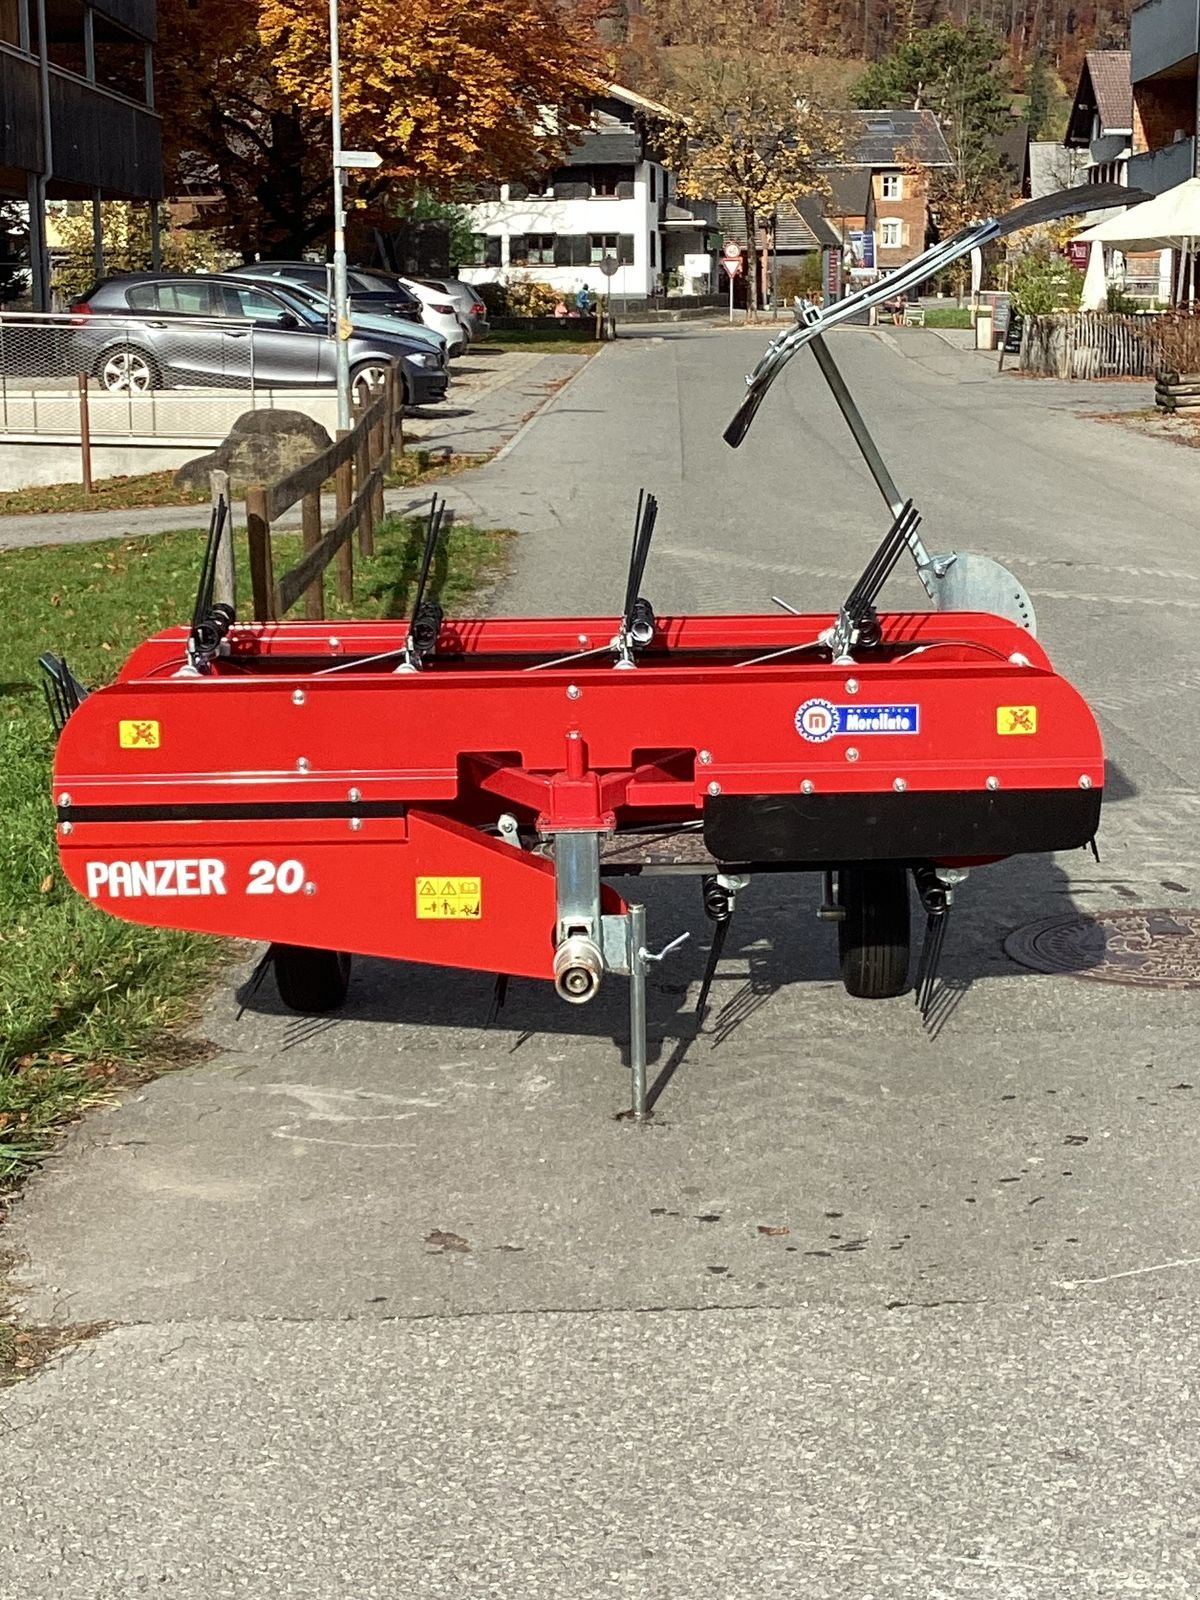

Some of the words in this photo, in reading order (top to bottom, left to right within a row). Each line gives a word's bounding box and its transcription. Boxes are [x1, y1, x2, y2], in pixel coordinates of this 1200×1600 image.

[846, 713, 910, 730] Morellato
[86, 858, 227, 898] PANZER
[246, 859, 305, 894] 20
